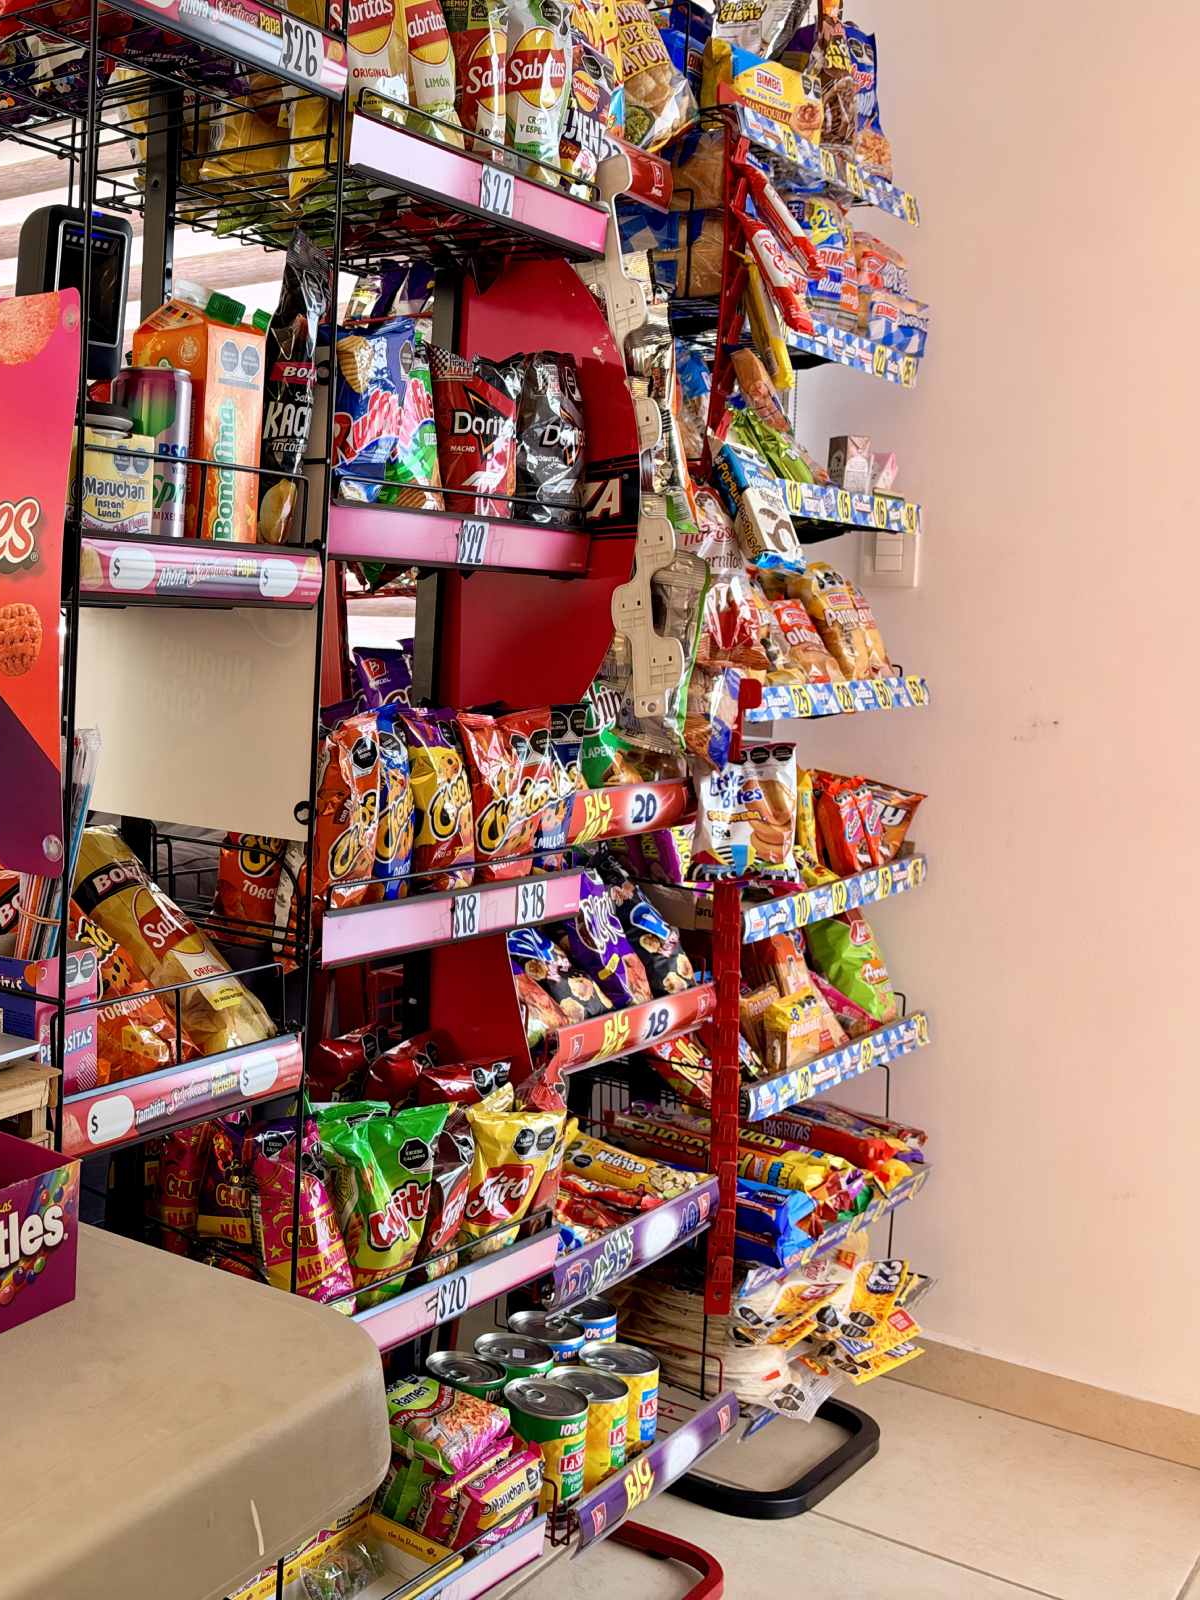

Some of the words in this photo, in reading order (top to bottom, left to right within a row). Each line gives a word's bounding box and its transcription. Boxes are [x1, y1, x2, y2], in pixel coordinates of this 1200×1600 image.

[408, 12, 447, 38] abritas
[283, 19, 318, 77] $26
[622, 43, 666, 75] ATUR
[353, 68, 390, 78] ORIGINAL
[425, 75, 450, 88] LIMÓN
[482, 165, 513, 217] $22
[450, 445, 476, 453] NACHO
[86, 476, 146, 500] Maruchan
[94, 499, 126, 510] Instant
[97, 509, 121, 519] Lunch
[153, 512, 179, 521] MIXE
[458, 524, 485, 563] $22
[157, 568, 187, 588] Ahora
[794, 688, 808, 715] 25
[632, 794, 657, 824] 20
[455, 894, 478, 934] $18
[522, 884, 545, 920] $18
[645, 1009, 669, 1039] 18
[243, 1070, 249, 1086] $
[91, 1115, 99, 1134] $
[136, 1101, 166, 1126] También
[437, 1275, 468, 1319] $20
[391, 1385, 431, 1408] Ramen
[560, 1422, 580, 1436] 10%
